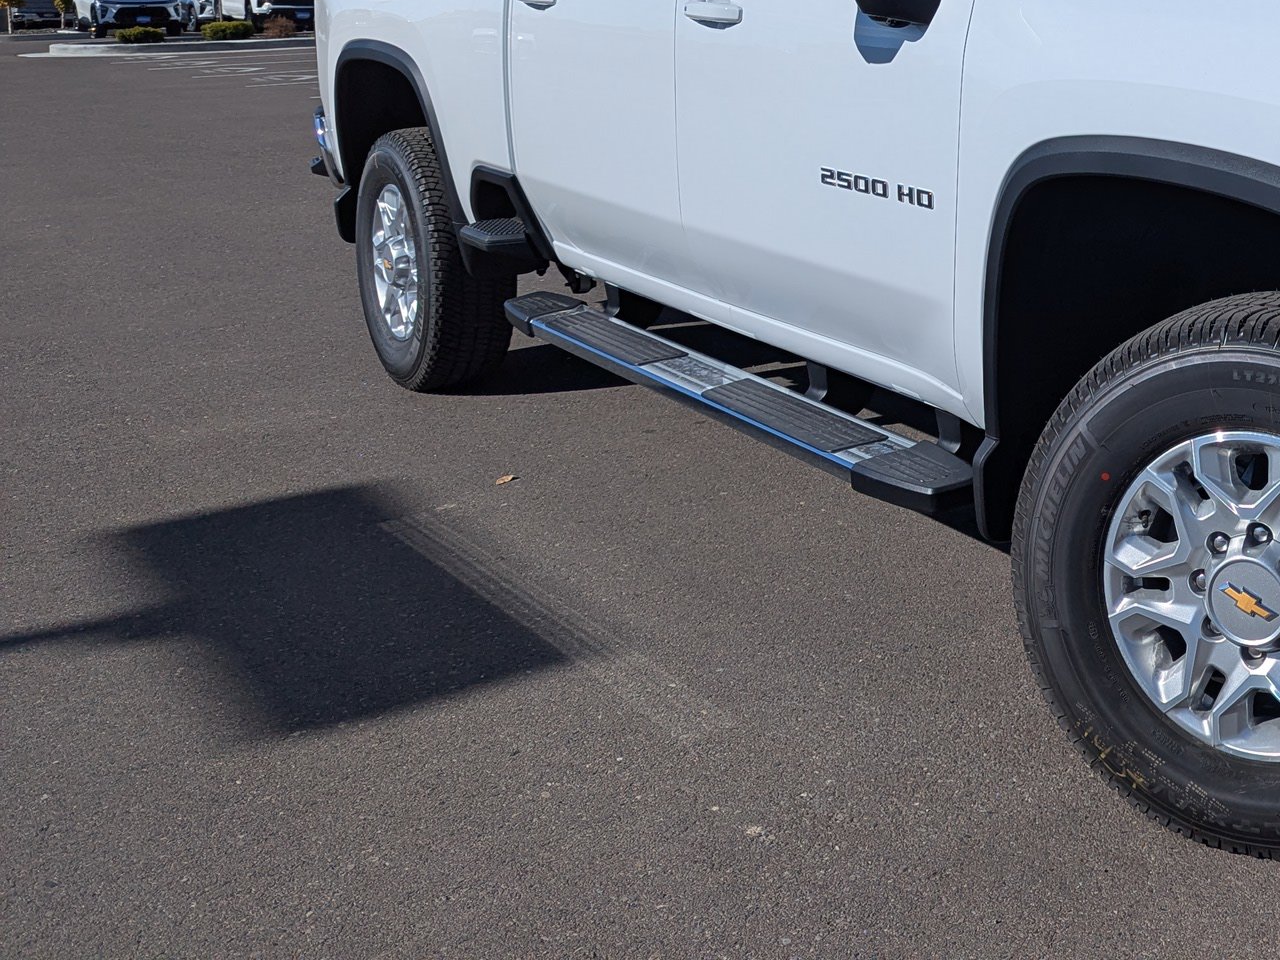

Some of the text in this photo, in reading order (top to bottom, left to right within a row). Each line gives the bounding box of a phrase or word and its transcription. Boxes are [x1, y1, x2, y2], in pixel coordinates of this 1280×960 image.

[820, 166, 934, 210] 2500 HD
[1035, 435, 1089, 581] MICHELIN
